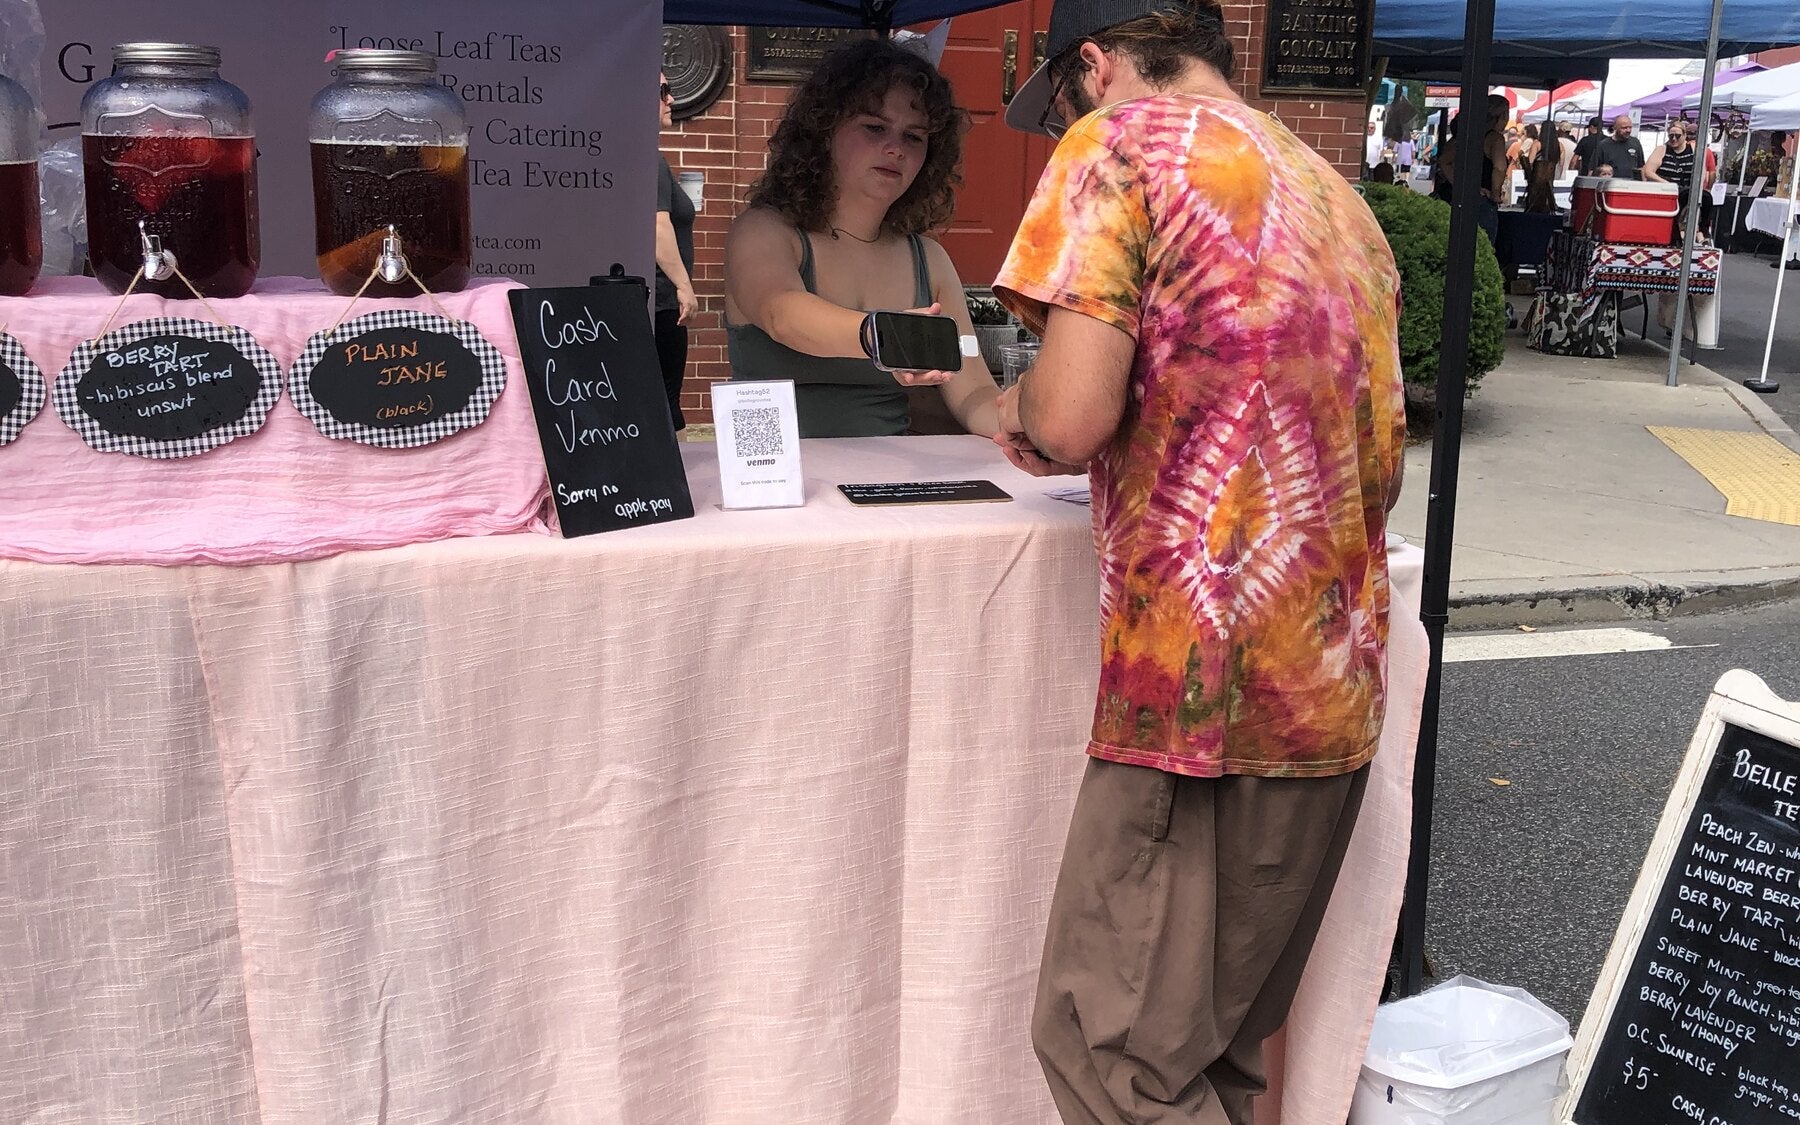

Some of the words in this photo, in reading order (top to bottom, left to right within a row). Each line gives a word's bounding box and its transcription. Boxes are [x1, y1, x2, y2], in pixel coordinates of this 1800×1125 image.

[1281, 13, 1357, 33] BANKING
[434, 31, 498, 60] Leaf
[503, 34, 562, 63] Teas
[1280, 39, 1357, 59] COMPANY
[1277, 64, 1331, 74] ESTABLISHED
[441, 74, 544, 105] Rentals
[486, 119, 603, 156] Catering
[469, 159, 512, 187] Tea
[523, 161, 614, 189] Events
[472, 235, 542, 250] tea.com
[474, 262, 536, 275] ea.com
[540, 300, 618, 348] Cash
[106, 341, 180, 368] BERRY
[149, 352, 210, 377] TART
[345, 340, 418, 366] PLAIN
[186, 364, 233, 387] blend
[377, 360, 448, 386] JANE
[546, 358, 618, 406] Card
[137, 392, 196, 418] unswt
[736, 388, 770, 397] Hashtag52
[376, 394, 434, 420] (black)
[555, 409, 640, 453] Venmo
[746, 458, 776, 467] venmo
[557, 483, 598, 506] Sorry
[602, 485, 619, 496] no
[615, 497, 649, 519] apple
[649, 498, 673, 517] pay
[1733, 748, 1798, 796] BELLE
[1699, 813, 1743, 845] PEACH
[1745, 832, 1776, 855] ZEN
[1691, 842, 1729, 864] MINT
[1733, 858, 1795, 883] MARKET
[1685, 864, 1754, 897] LAVENDER
[1670, 908, 1713, 935] PLAIN
[1719, 927, 1760, 951] JANE
[1742, 905, 1785, 929] TART
[1657, 936, 1701, 964] SWEET
[1707, 958, 1745, 982] MINT
[1753, 980, 1786, 997] green
[1649, 961, 1690, 997] BERRY
[1698, 980, 1722, 1009] JOY
[1726, 989, 1771, 1017] PUNCH
[1640, 986, 1682, 1021] BERRY
[1685, 1004, 1756, 1043] LAVENDER
[1627, 1023, 1654, 1047] O.C.
[1656, 1033, 1716, 1076] SUNRISE
[1738, 1066, 1770, 1089] black
[1771, 1079, 1789, 1101] tea,
